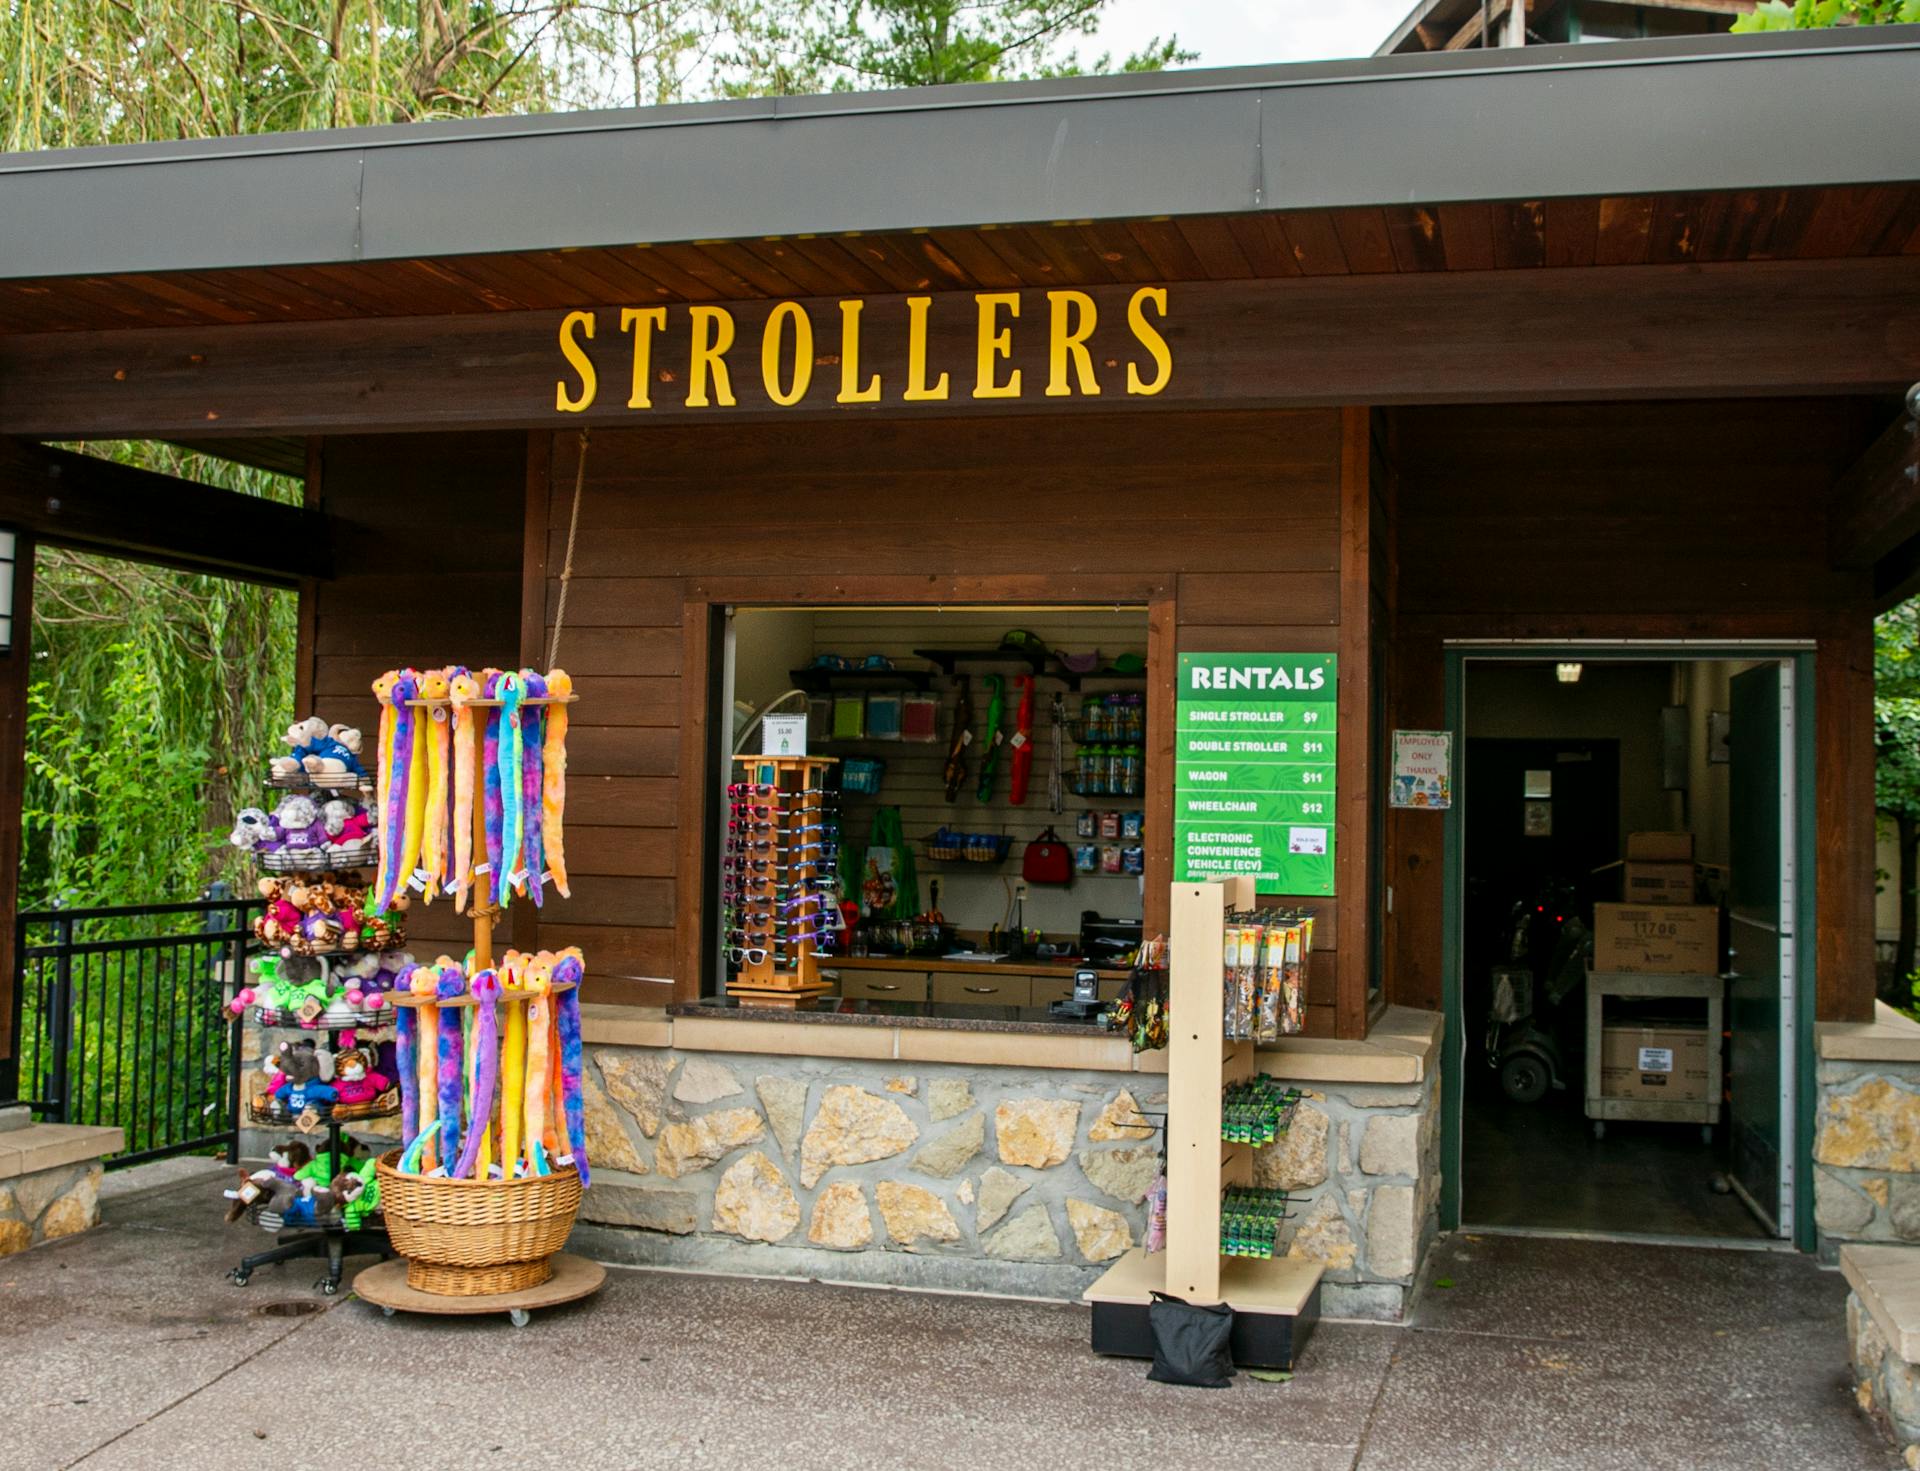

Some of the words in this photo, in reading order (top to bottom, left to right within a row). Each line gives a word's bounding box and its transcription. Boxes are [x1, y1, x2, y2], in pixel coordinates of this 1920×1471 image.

[555, 287, 1173, 413] STROLLERS
[1191, 666, 1325, 690] RENTALS
[1189, 711, 1228, 722] SINGLE
[1229, 711, 1284, 722] STROLLER
[1303, 711, 1318, 724] $9
[1189, 741, 1232, 751] DOUBLE
[1233, 741, 1288, 752] STROLLER
[1303, 741, 1323, 753] $11
[1400, 736, 1446, 746] EMPLOYEES
[1411, 752, 1433, 761] ONLY
[1405, 766, 1438, 775] THANKS
[1188, 771, 1228, 782] WAGON
[1302, 772, 1323, 784] $11
[1188, 801, 1257, 812] WHEELCHAIR
[1302, 803, 1323, 815] $12
[1187, 832, 1254, 843] ELECTRONIC
[1187, 845, 1262, 857] CONVENIENCE
[1186, 859, 1232, 870] VEHICLE
[1233, 859, 1262, 872] (ECV)
